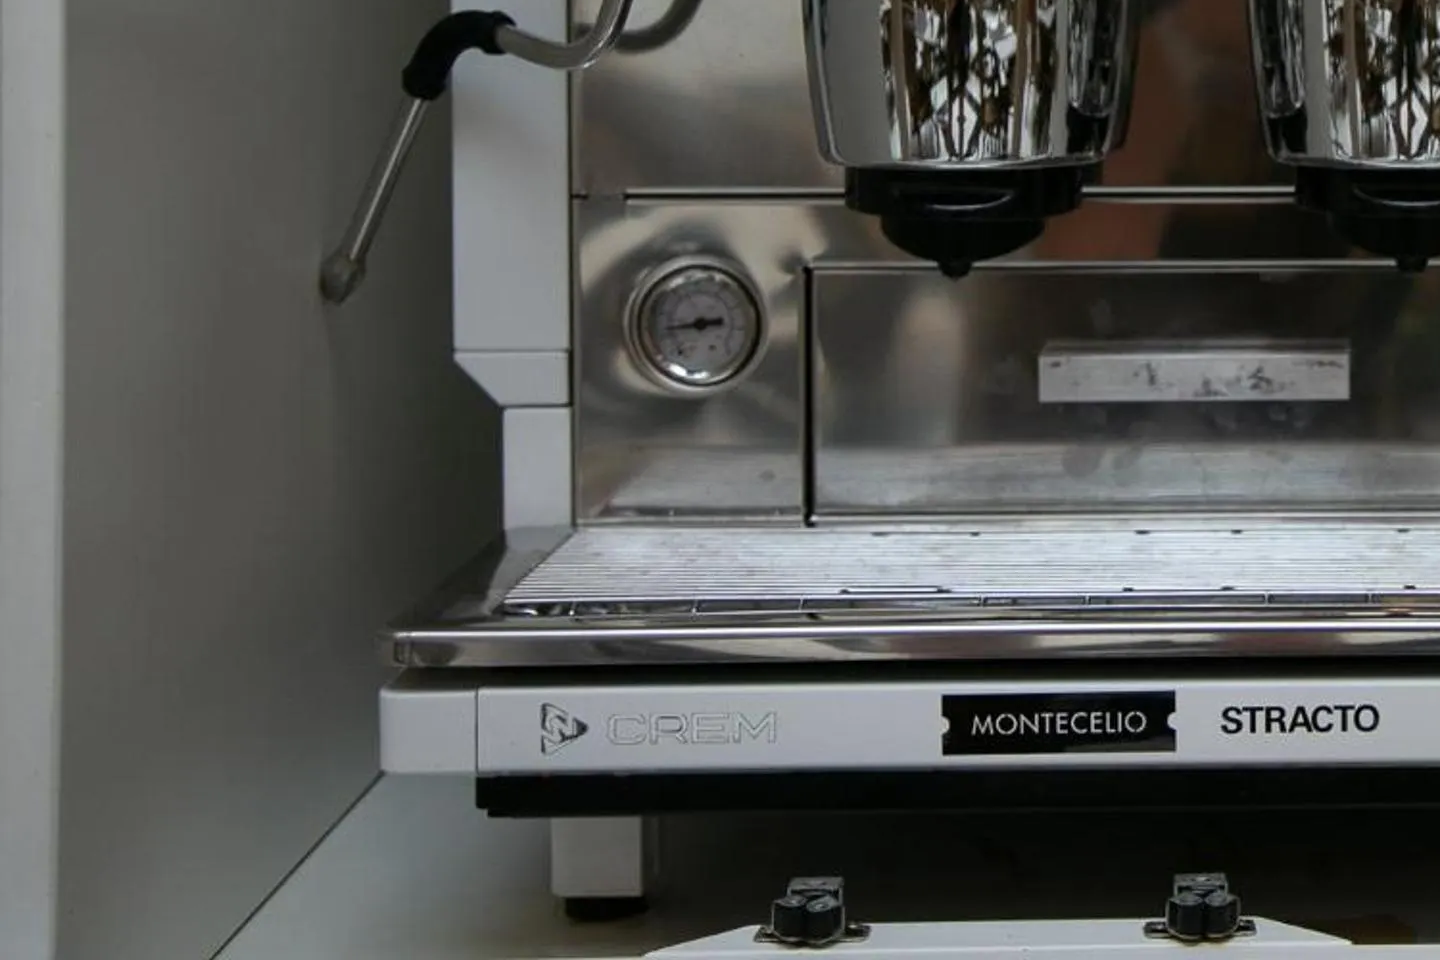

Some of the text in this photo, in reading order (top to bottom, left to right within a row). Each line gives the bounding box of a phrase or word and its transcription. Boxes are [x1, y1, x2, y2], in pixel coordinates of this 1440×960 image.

[607, 711, 778, 746] CREM
[970, 711, 1147, 737] MONTECELIO
[1220, 704, 1380, 734] STRACTO
